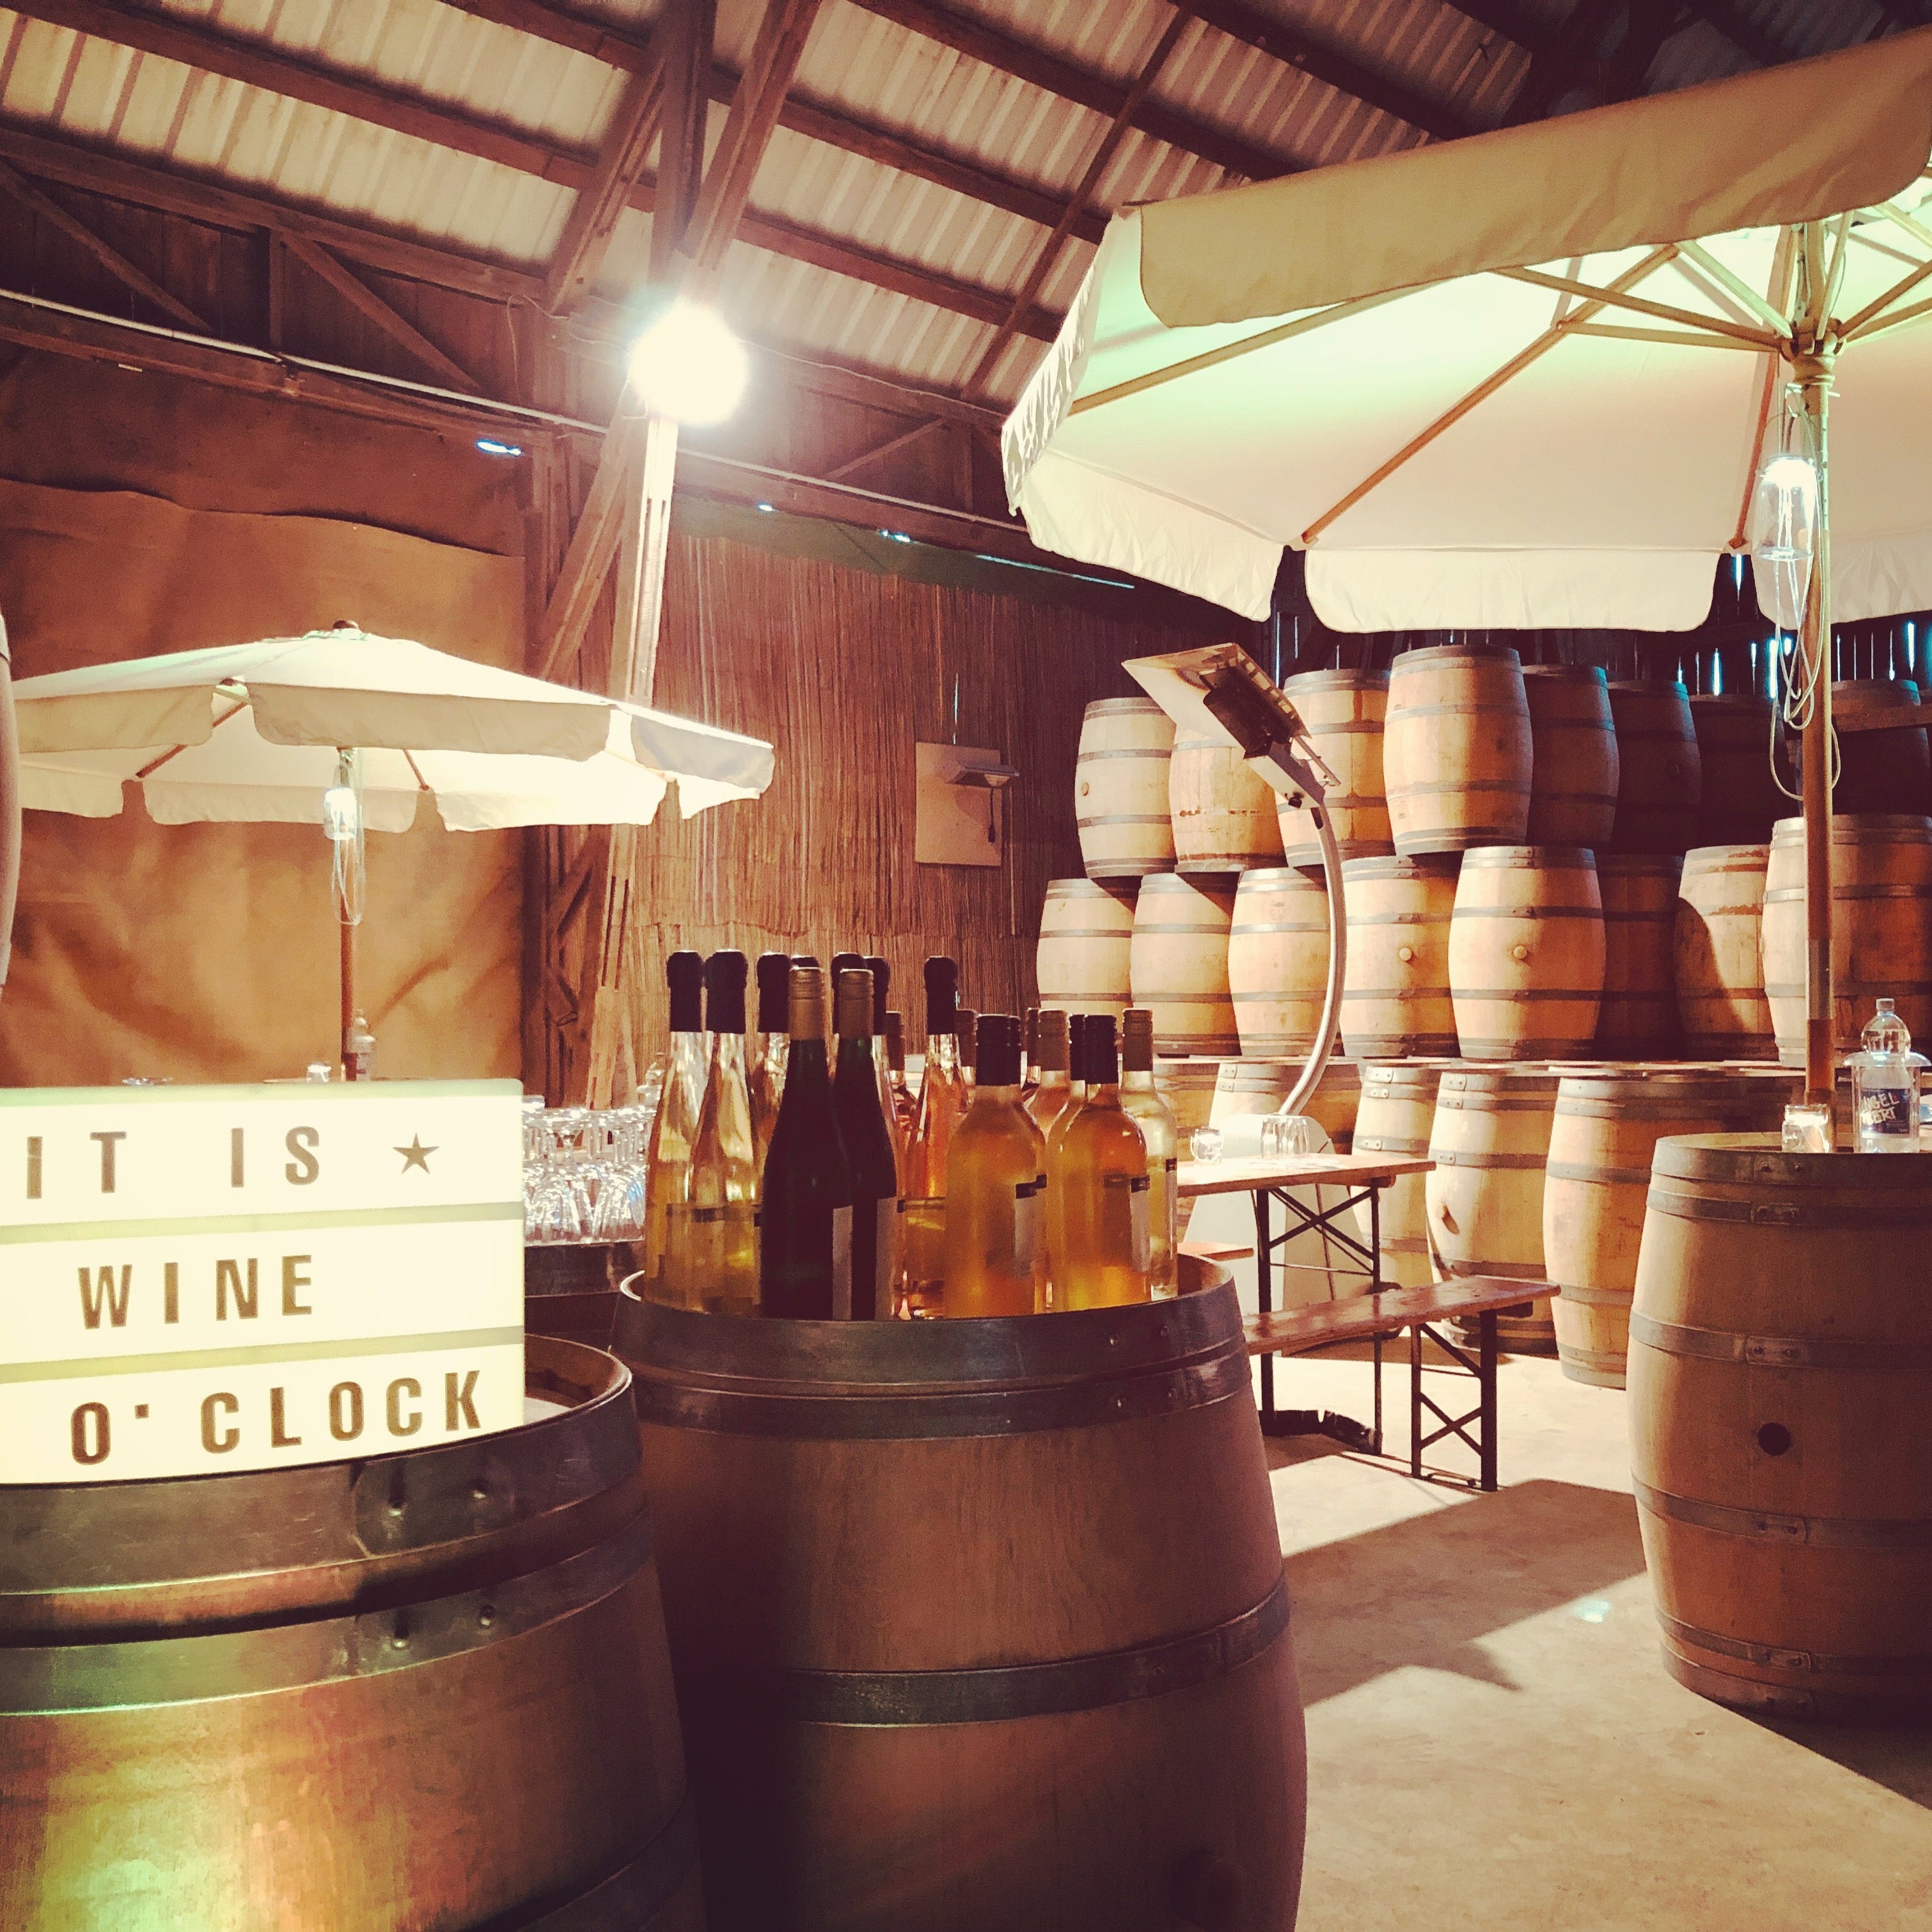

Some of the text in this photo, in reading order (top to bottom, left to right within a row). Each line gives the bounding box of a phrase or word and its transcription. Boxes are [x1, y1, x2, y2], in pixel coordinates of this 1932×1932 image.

[26, 1126, 320, 1200] IT IS
[77, 1254, 313, 1330] WINE
